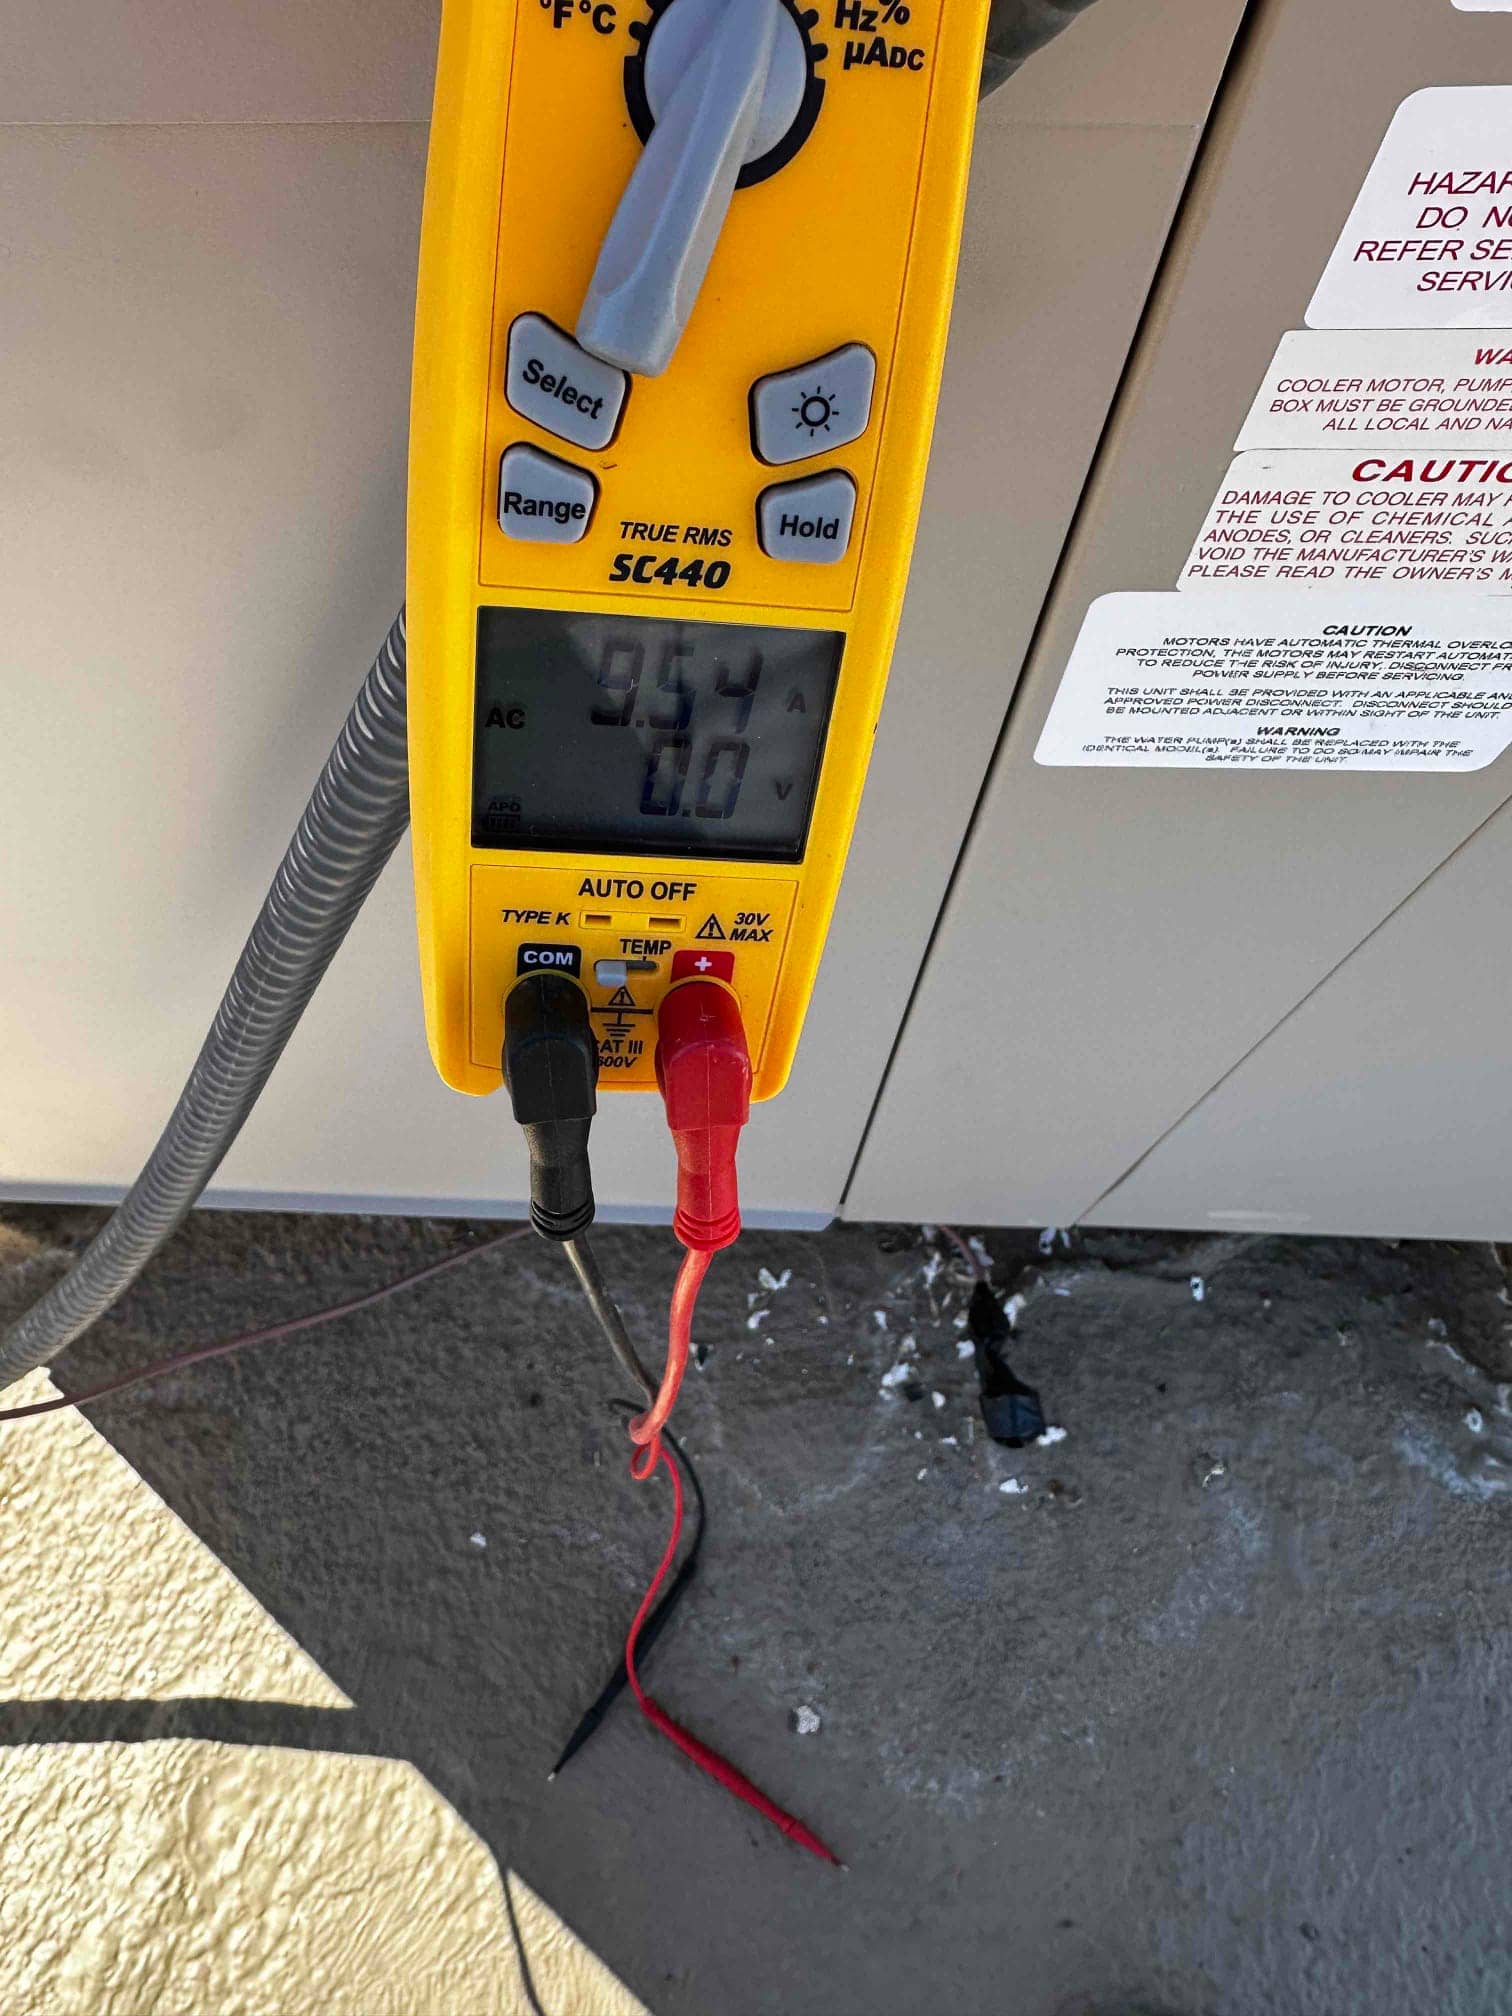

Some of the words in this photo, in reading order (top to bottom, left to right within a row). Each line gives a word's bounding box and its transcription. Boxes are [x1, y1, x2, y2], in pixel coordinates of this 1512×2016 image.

[1416, 206, 1468, 229] DO
[1482, 206, 1512, 228] N
[1353, 240, 1464, 262] REFER
[1470, 239, 1512, 260] SE
[1416, 271, 1512, 291] SERVI
[522, 359, 604, 420] Select
[1277, 379, 1363, 392] COOLER
[1366, 379, 1445, 394] MOTOR,
[1269, 399, 1313, 412] BOX
[1315, 399, 1374, 412] MUST
[1376, 399, 1404, 412] BE
[1408, 398, 1512, 412] GROUNDE
[1322, 417, 1359, 431] ALL
[1364, 417, 1431, 431] LOCAL
[1435, 417, 1482, 431] AND
[1221, 490, 1316, 505] DAMAGE
[1322, 491, 1350, 505] TO
[1356, 491, 1448, 507] COOLER
[1451, 493, 1503, 507] MAY
[503, 492, 586, 524] Range
[1216, 510, 1261, 524] THE
[1270, 510, 1320, 525] USE
[1328, 511, 1363, 525] OF
[1372, 511, 1494, 527] CHEMICAL
[619, 521, 679, 542] TRUE
[682, 524, 732, 546] RMS
[779, 514, 839, 539] Hold
[1203, 529, 1291, 545] ANODES,
[1299, 530, 1332, 543] OR
[1340, 530, 1452, 544] CLEANERS.
[1465, 531, 1512, 545] SUC
[1198, 547, 1245, 561] VOID
[1253, 547, 1293, 561] THE
[1297, 549, 1485, 562] MANUFACTURER'S
[609, 554, 731, 588] SC440
[1188, 565, 1269, 578] PLEASE
[1275, 565, 1334, 578] READ
[1344, 566, 1386, 579] THE
[1392, 566, 1495, 580] OWNER'S
[1322, 626, 1412, 636] CAUTION
[1163, 637, 1230, 646] MOTORS
[1234, 638, 1275, 646] HAVE
[1277, 639, 1368, 648] AUTOMATIC
[1373, 640, 1441, 649] THERMAL
[1224, 649, 1251, 657] THE
[1256, 649, 1324, 658] MOTORS
[1327, 650, 1361, 659] MAY
[1363, 651, 1435, 660] RESTART
[1436, 652, 1512, 660] AUTOMAT
[1137, 659, 1157, 667] TO
[1161, 659, 1225, 667] REDUCE
[1229, 660, 1257, 668] THE
[1261, 660, 1299, 668] RISK
[1388, 662, 1491, 671] DISCONNECT
[1192, 670, 1249, 678] POWER
[1252, 671, 1313, 679] SUPPLY
[1315, 672, 1380, 680] BEFORE
[1381, 673, 1465, 681] SERVICING.
[1107, 687, 1139, 695] THIS
[1143, 687, 1178, 695] UNIT
[1179, 688, 1223, 696] SHALL
[1252, 689, 1328, 697] PROVIDED
[1332, 690, 1369, 698] WITH
[1398, 691, 1486, 700] APPLICABLE
[1488, 692, 1512, 700] AN
[1104, 697, 1183, 705] APPROVED
[1187, 698, 1241, 706] POWER
[1352, 700, 1449, 709] DISCONNECT
[485, 707, 525, 729] AC
[1128, 707, 1200, 715] MOUNTED
[1202, 708, 1279, 716] ADJACENT
[1280, 708, 1303, 716] OR
[1306, 709, 1357, 717] WITHIN
[1359, 710, 1405, 718] SIGHT
[1407, 710, 1432, 718] OF
[1256, 727, 1340, 736] WARNING
[1104, 736, 1132, 744] THE
[1245, 738, 1287, 746] SHALL
[1314, 739, 1389, 747] REPLACED
[1392, 740, 1430, 748] WITH
[640, 731, 750, 818] 0.0
[578, 878, 643, 899] AUTO
[650, 881, 697, 901] OFF
[502, 909, 552, 924] TYPE
[555, 912, 571, 925] K
[734, 912, 770, 926] 30V
[729, 928, 773, 942] MAX
[620, 938, 672, 955] TEMP
[523, 950, 573, 965] COM
